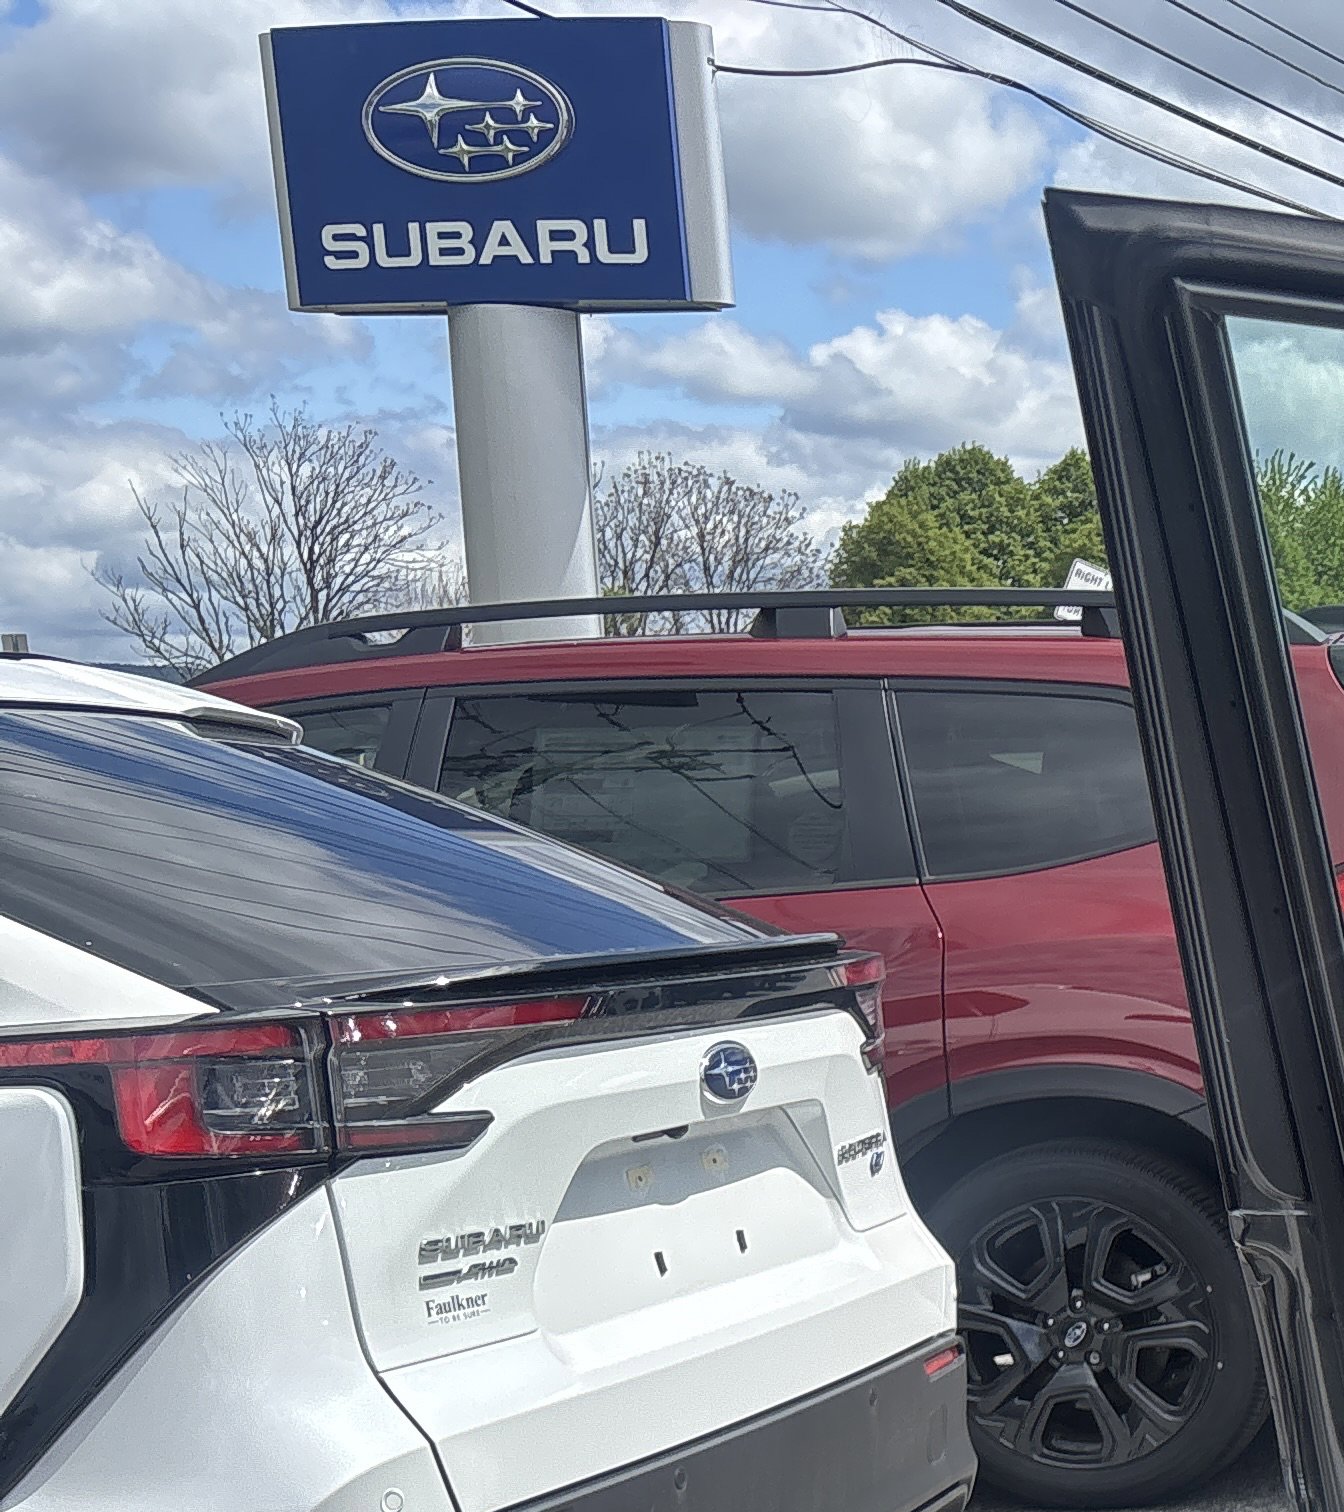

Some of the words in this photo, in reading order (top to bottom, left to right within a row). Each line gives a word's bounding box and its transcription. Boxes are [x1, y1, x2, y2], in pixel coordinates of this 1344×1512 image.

[321, 218, 649, 270] SUBARU
[1075, 568, 1104, 587] RIGHT
[418, 1219, 546, 1266] SUBARU
[424, 1293, 488, 1318] Faulkner
